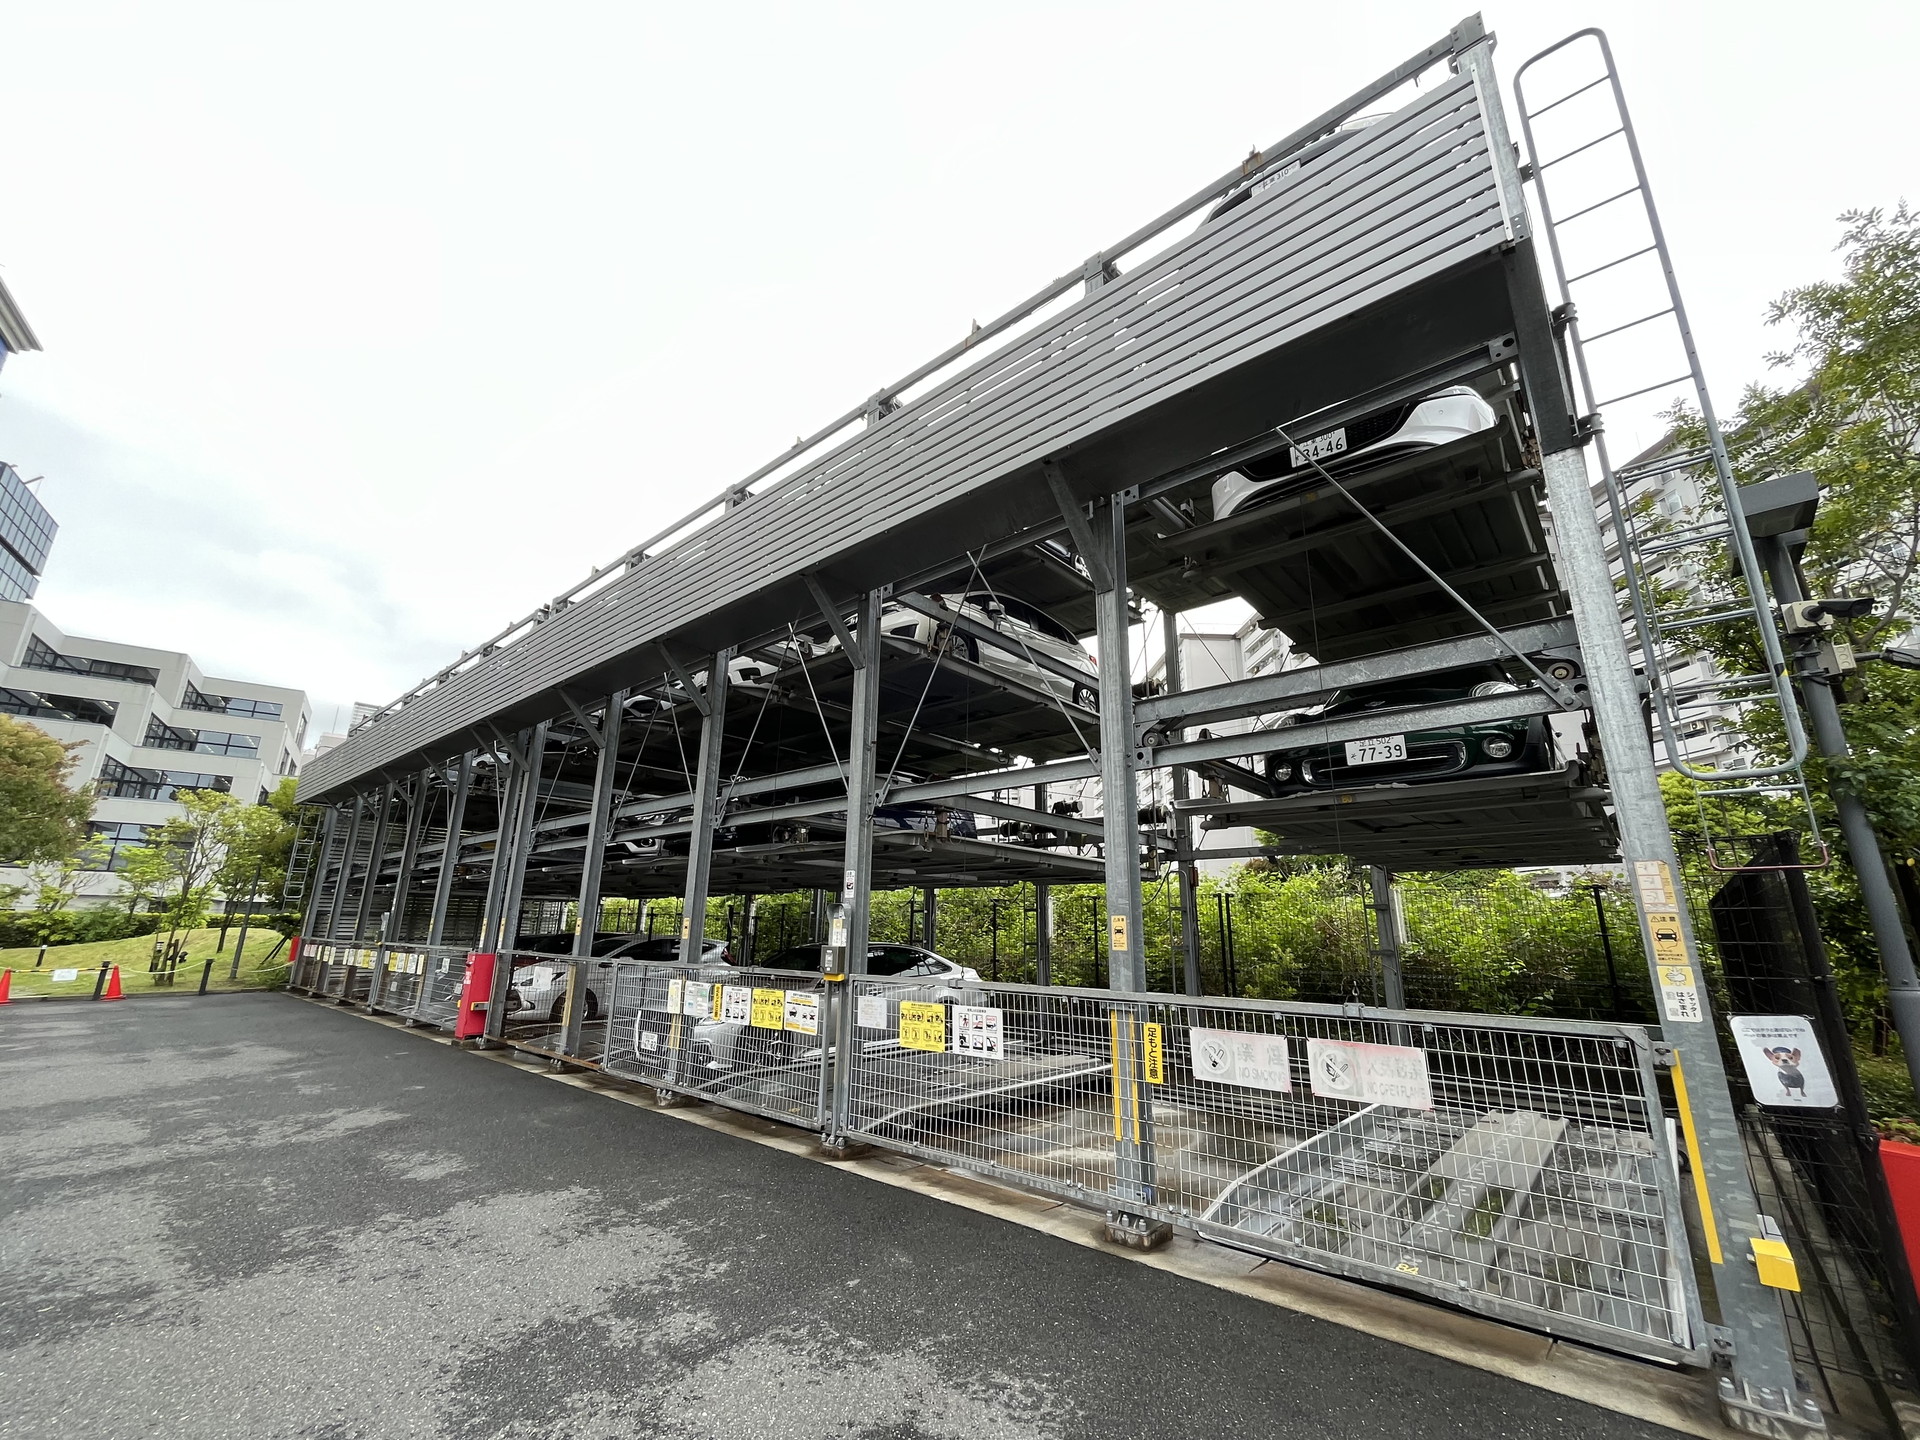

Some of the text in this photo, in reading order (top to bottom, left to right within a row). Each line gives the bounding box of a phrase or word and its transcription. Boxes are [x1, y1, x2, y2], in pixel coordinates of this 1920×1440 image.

[1303, 437, 1343, 461] 34-46
[1376, 736, 1391, 745] 502
[1359, 744, 1403, 762] 77-39
[1676, 991, 1690, 1017] はさまれ
[1686, 991, 1697, 1018] シャッター
[1148, 1027, 1159, 1079] 足もと注意
[1239, 1066, 1250, 1079] NO
